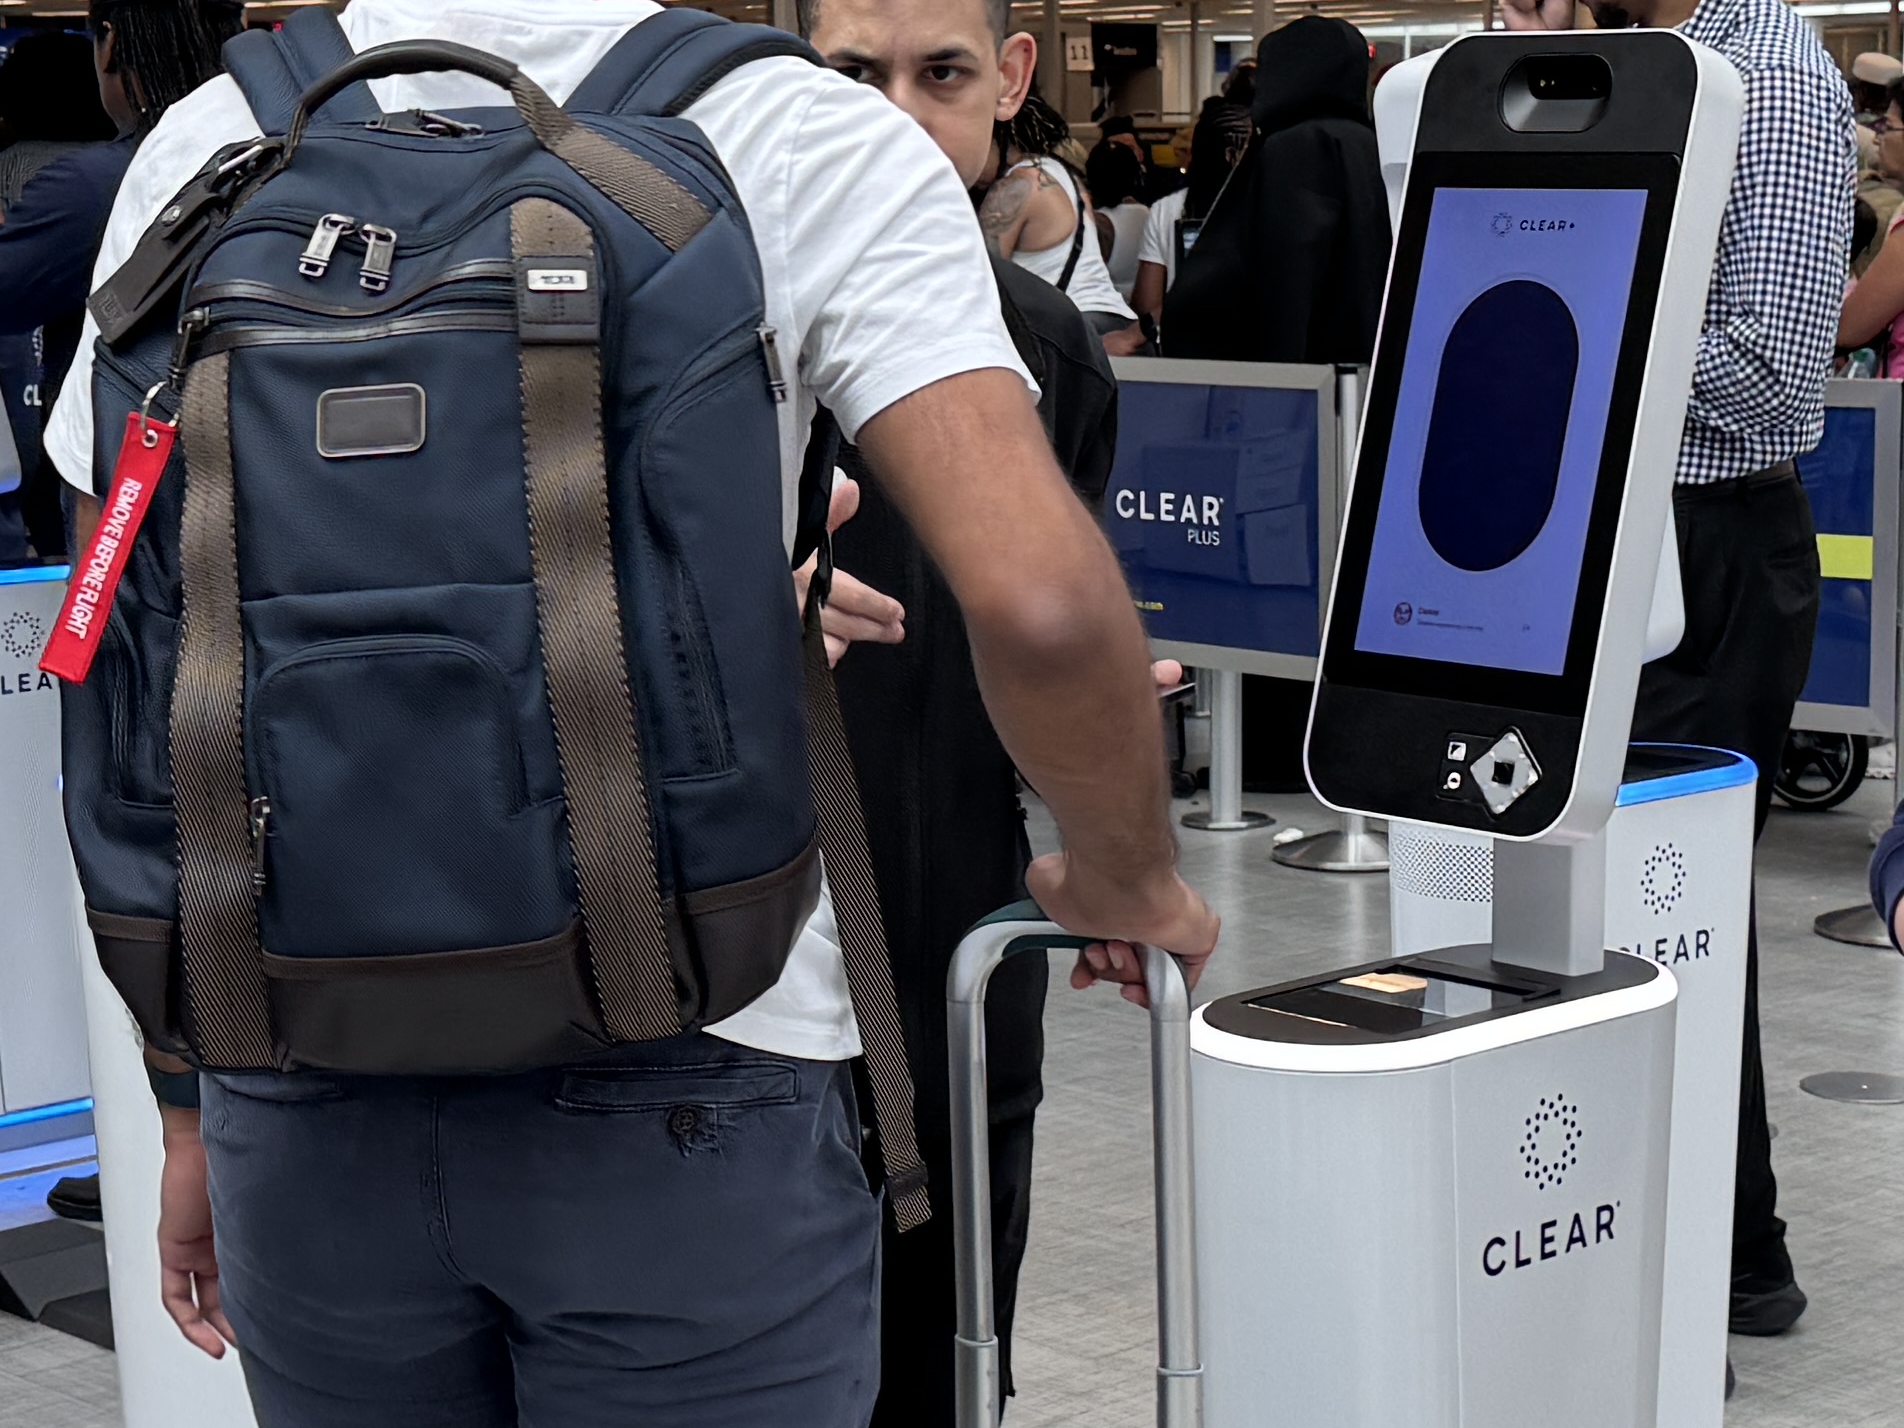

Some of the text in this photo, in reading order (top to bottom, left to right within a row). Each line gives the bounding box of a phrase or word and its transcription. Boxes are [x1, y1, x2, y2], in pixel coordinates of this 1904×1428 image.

[1070, 44, 1089, 60] 11
[1116, 489, 1221, 526] CLEAR
[1187, 528, 1221, 546] PLUS
[64, 476, 143, 640] REMOVE BEFORE FLIGHT
[1619, 929, 1710, 966] EAR
[1482, 1203, 1616, 1277] CLEAR
